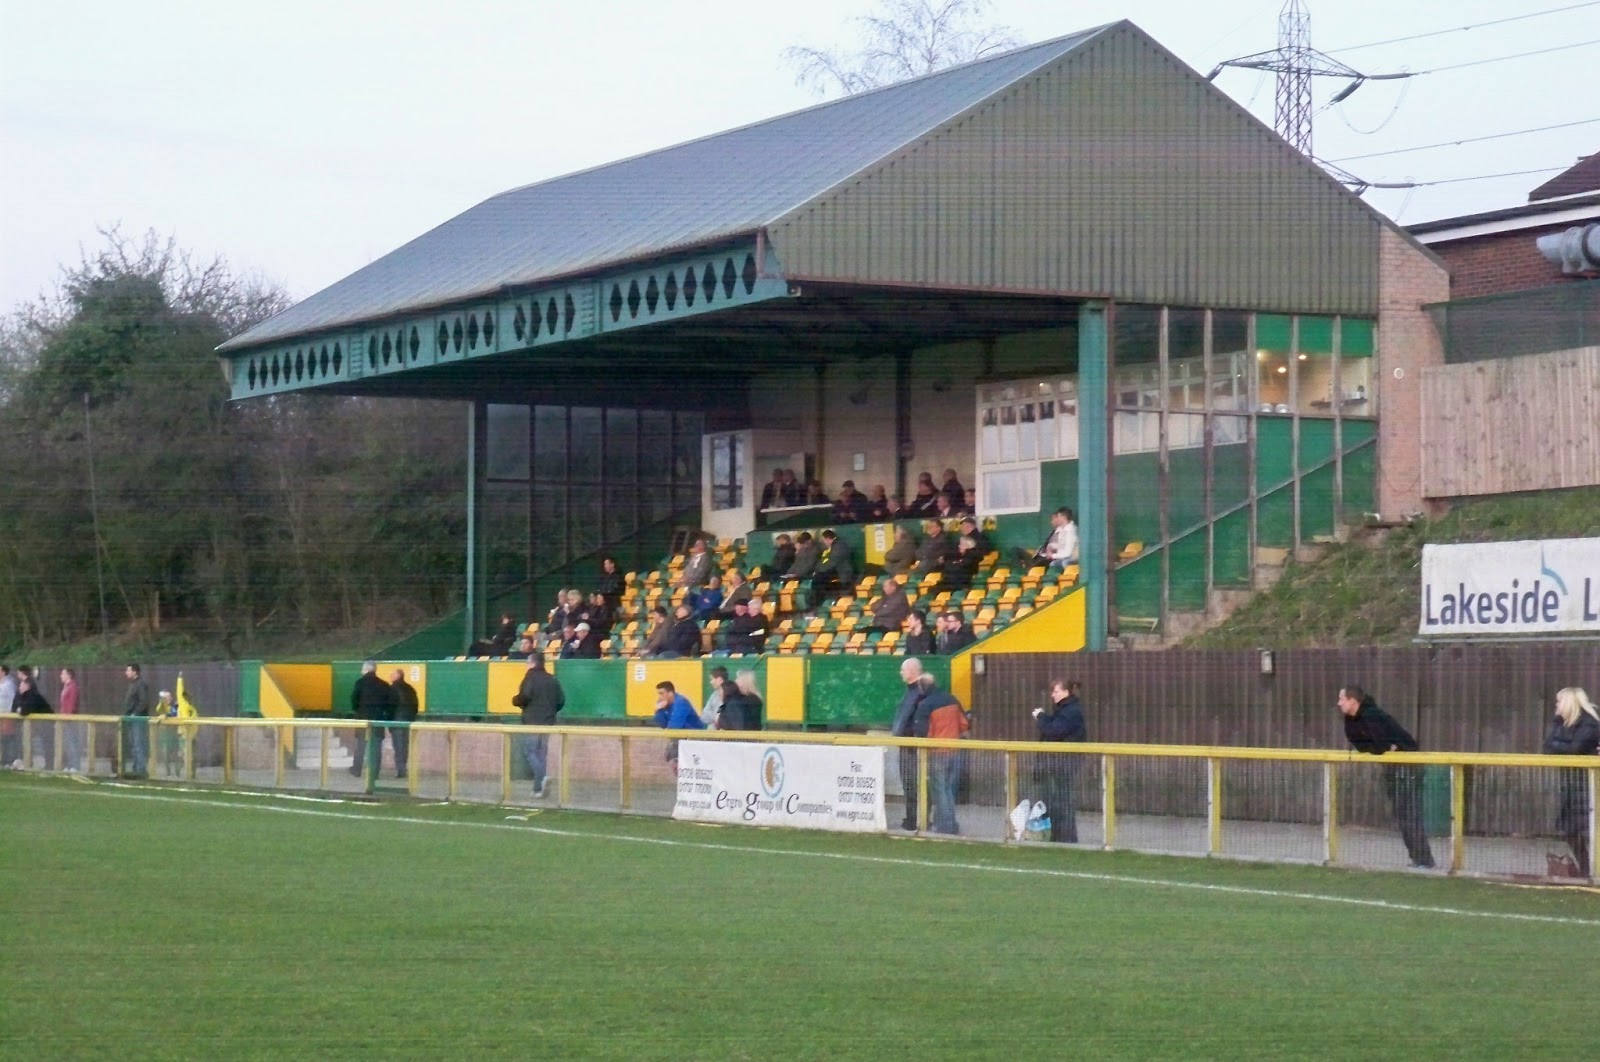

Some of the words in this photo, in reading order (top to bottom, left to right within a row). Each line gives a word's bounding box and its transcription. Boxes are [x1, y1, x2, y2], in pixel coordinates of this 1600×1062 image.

[1425, 578, 1560, 626] Lakeside
[1583, 577, 1600, 622] L
[775, 797, 785, 811] of
[787, 793, 833, 817] Companies
